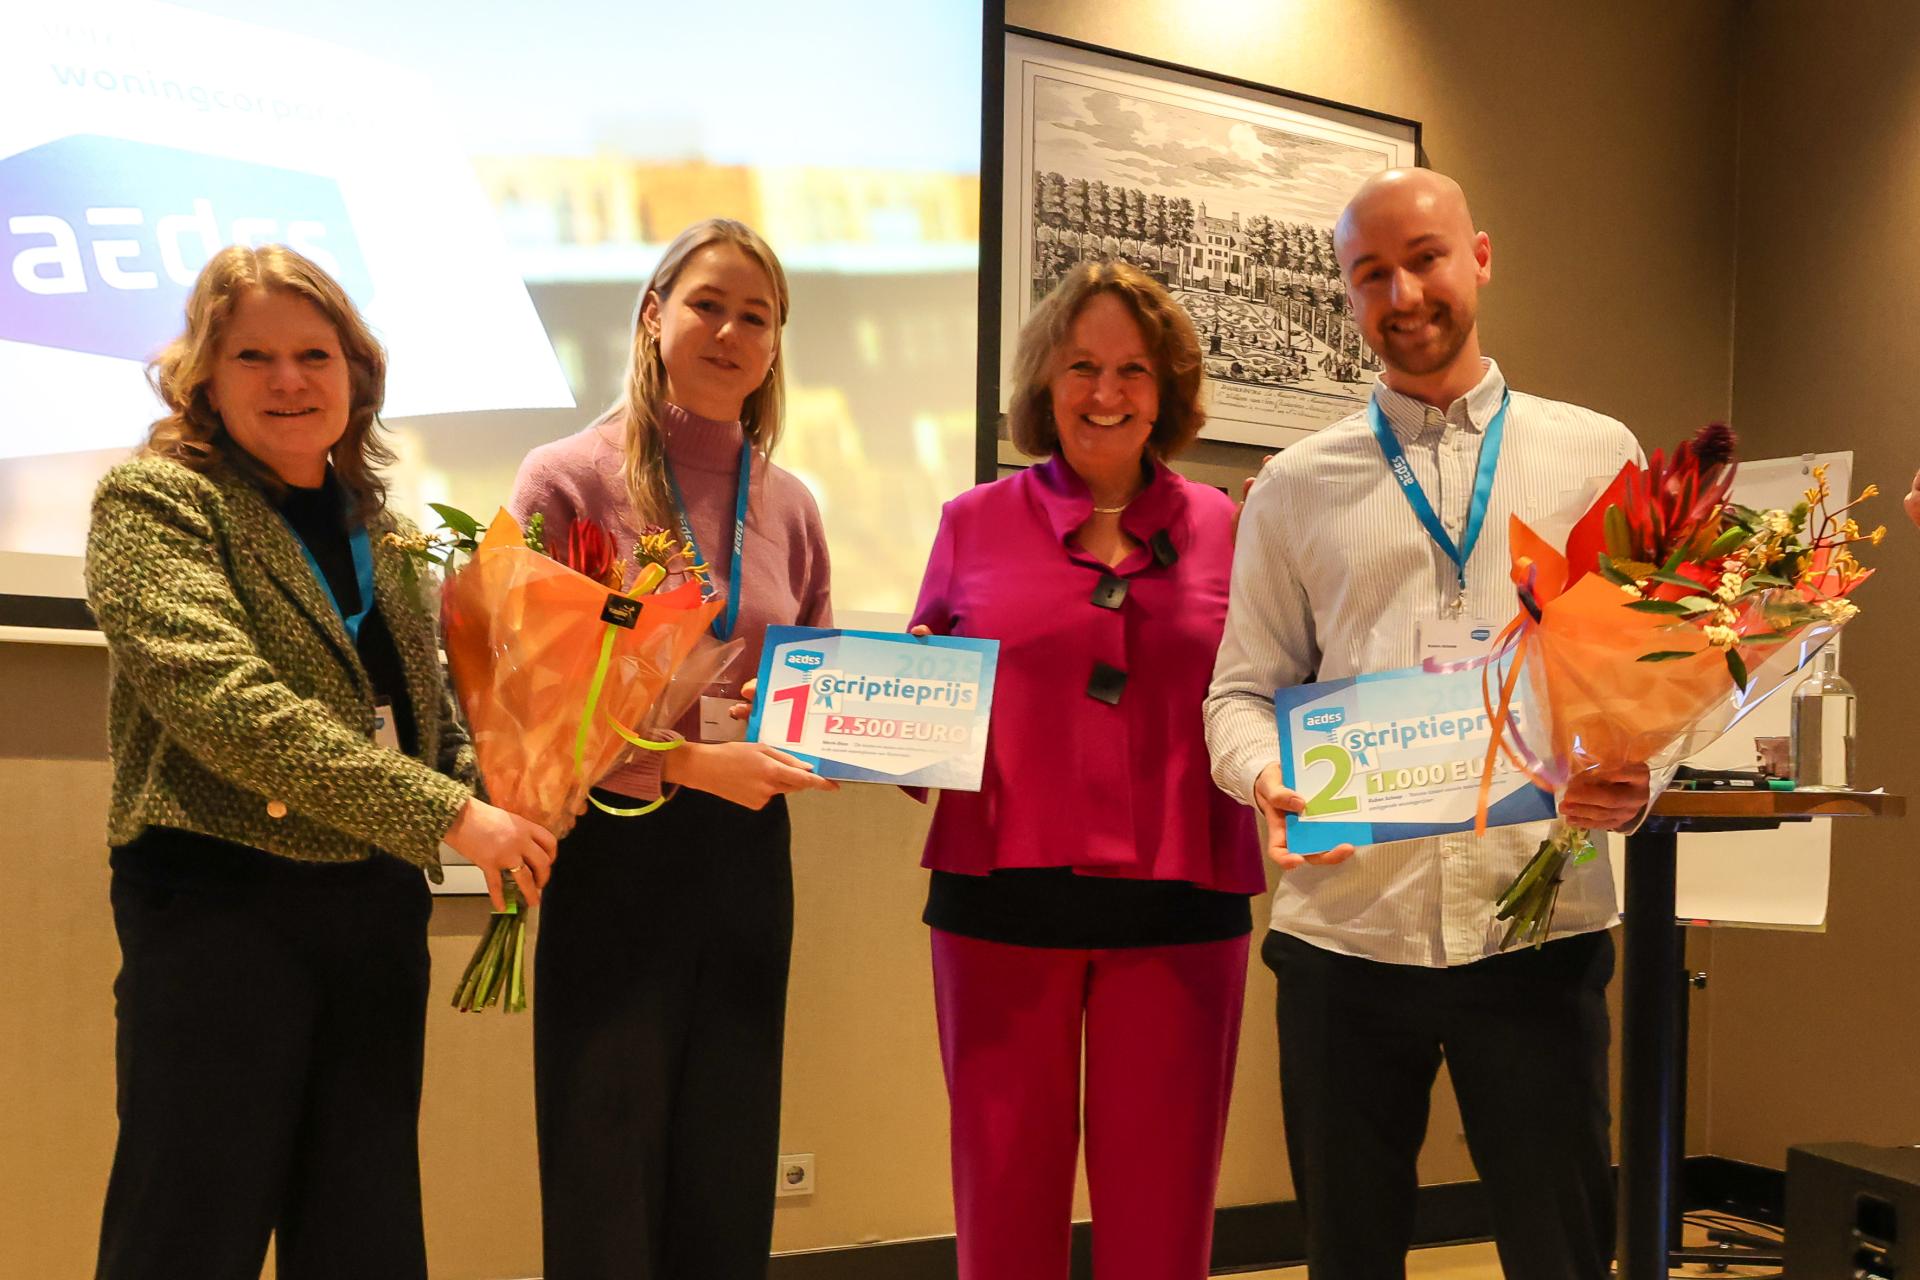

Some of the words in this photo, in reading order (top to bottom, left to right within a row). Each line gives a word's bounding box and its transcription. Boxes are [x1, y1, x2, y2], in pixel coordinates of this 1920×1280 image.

[820, 675, 973, 706] scriptieprijs
[773, 683, 811, 743] 1
[828, 715, 896, 738] 2.500
[900, 720, 969, 744] EURO
[1349, 707, 1521, 749] scriptieprs
[1303, 744, 1358, 817] 2
[1369, 763, 1448, 793] 1.000
